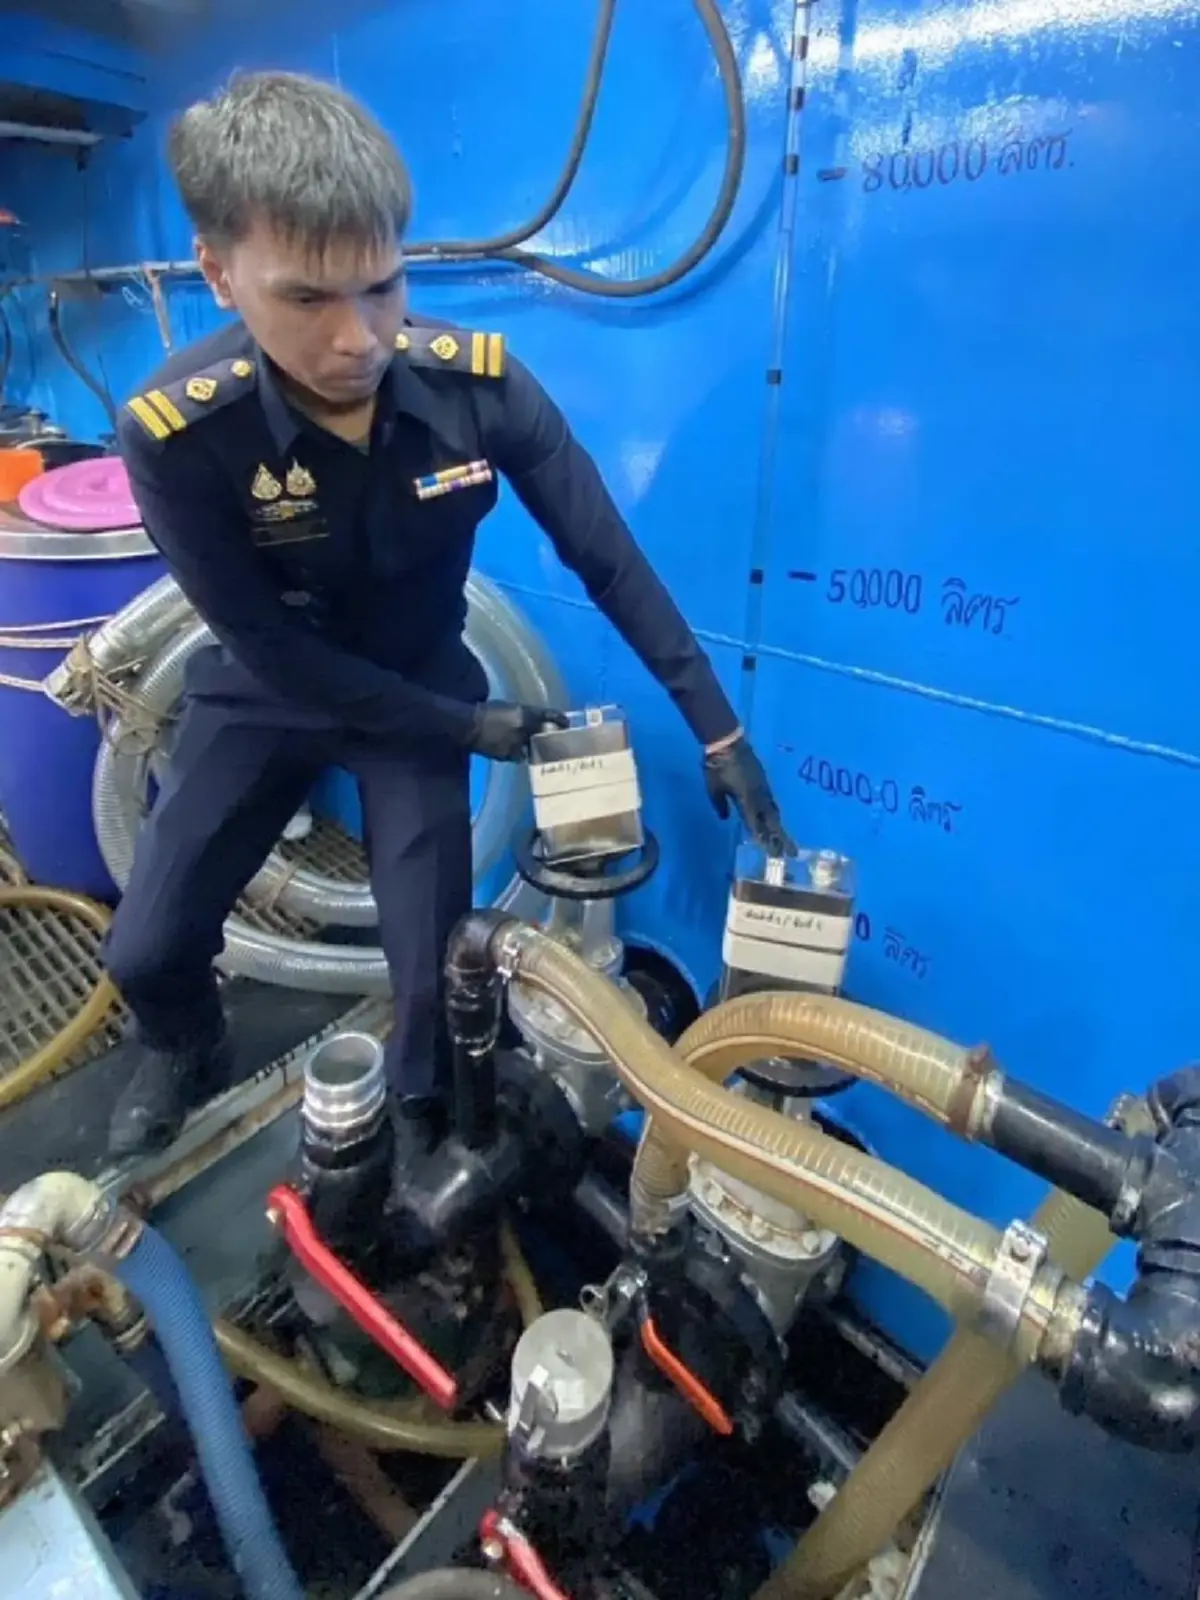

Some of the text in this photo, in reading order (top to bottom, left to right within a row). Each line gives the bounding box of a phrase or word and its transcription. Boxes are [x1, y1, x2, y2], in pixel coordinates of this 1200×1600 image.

[826, 568, 1020, 634] 50,000 ลิตร
[908, 785, 962, 832] ลิตร
